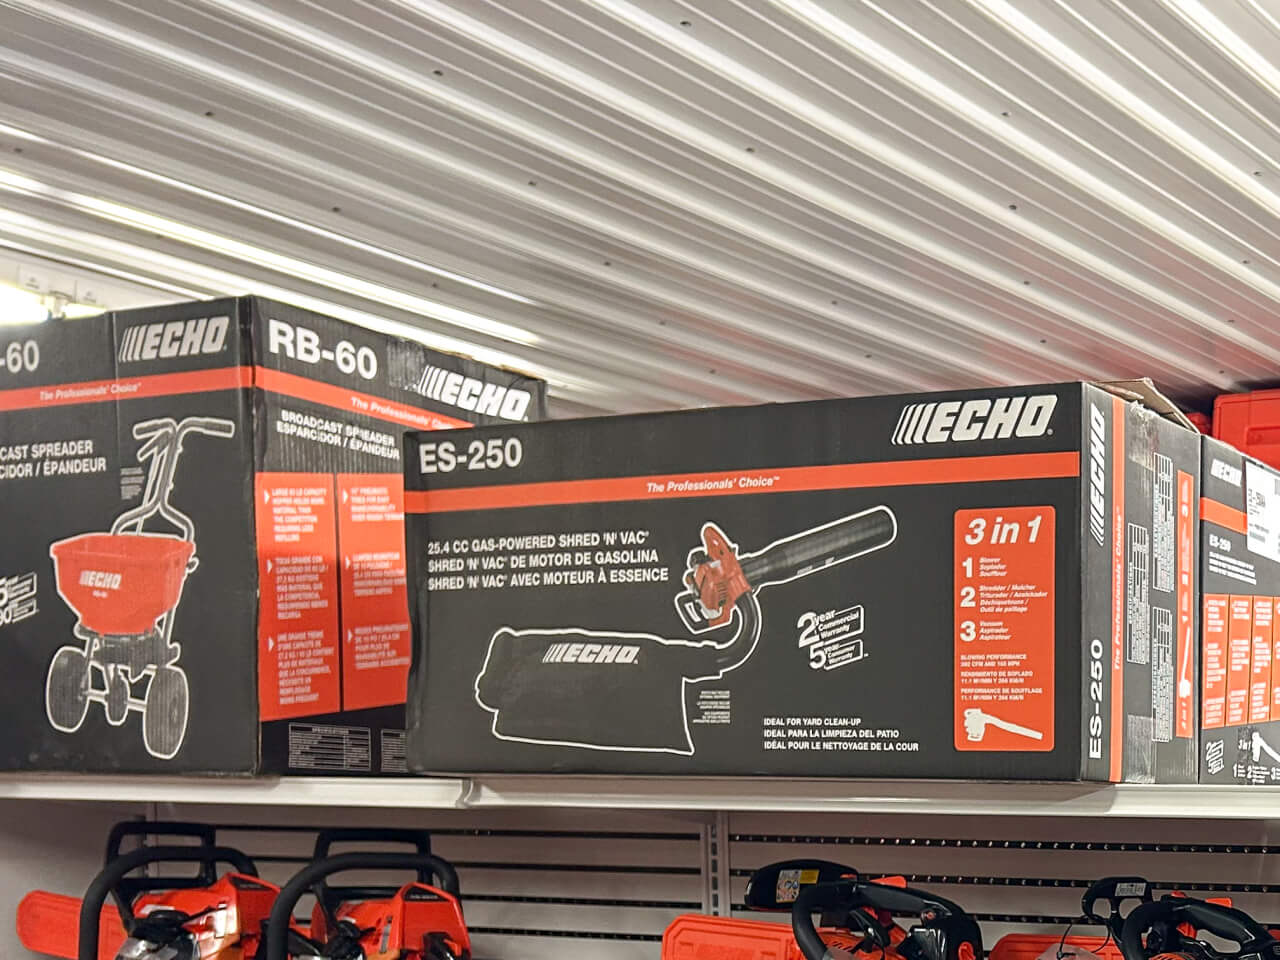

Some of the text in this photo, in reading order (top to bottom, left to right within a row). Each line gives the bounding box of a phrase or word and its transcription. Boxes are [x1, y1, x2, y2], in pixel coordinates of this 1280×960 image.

[141, 317, 229, 359] ECHO
[269, 319, 377, 380] RB-60
[441, 372, 530, 421] ECHO
[281, 410, 395, 447] BROADCAST SPREADER
[927, 395, 1057, 442] ECHO
[32, 440, 93, 458] SPREADER
[420, 438, 522, 474] ES-250
[1090, 409, 1104, 512] ECHO
[43, 457, 106, 476] ÉPANDEUR
[647, 477, 774, 493] The Professionals' Choice
[965, 516, 1041, 544] 3 in 1
[428, 532, 645, 555] 25.4 GAS-POWERED SHRED VAC
[428, 549, 658, 573] SHRED VAC MOTOR GASOLINA
[962, 558, 972, 578] 1
[86, 574, 121, 590] ECHO
[428, 567, 669, 590] SHRED VAC AVEC MOTEUR À ESSENCE
[960, 587, 976, 607] 2
[797, 612, 820, 648] 2
[960, 621, 976, 642] 3
[563, 644, 638, 664] ECHO
[1090, 640, 1103, 760] ES-250
[764, 718, 861, 726] IDEAL FOR YARD CLEAN-UP
[764, 729, 899, 738] IDEAL PARA LIMPIEZA DEL PATIO
[764, 739, 918, 751] IDÉAL POUR NETTOYAGE COUR
